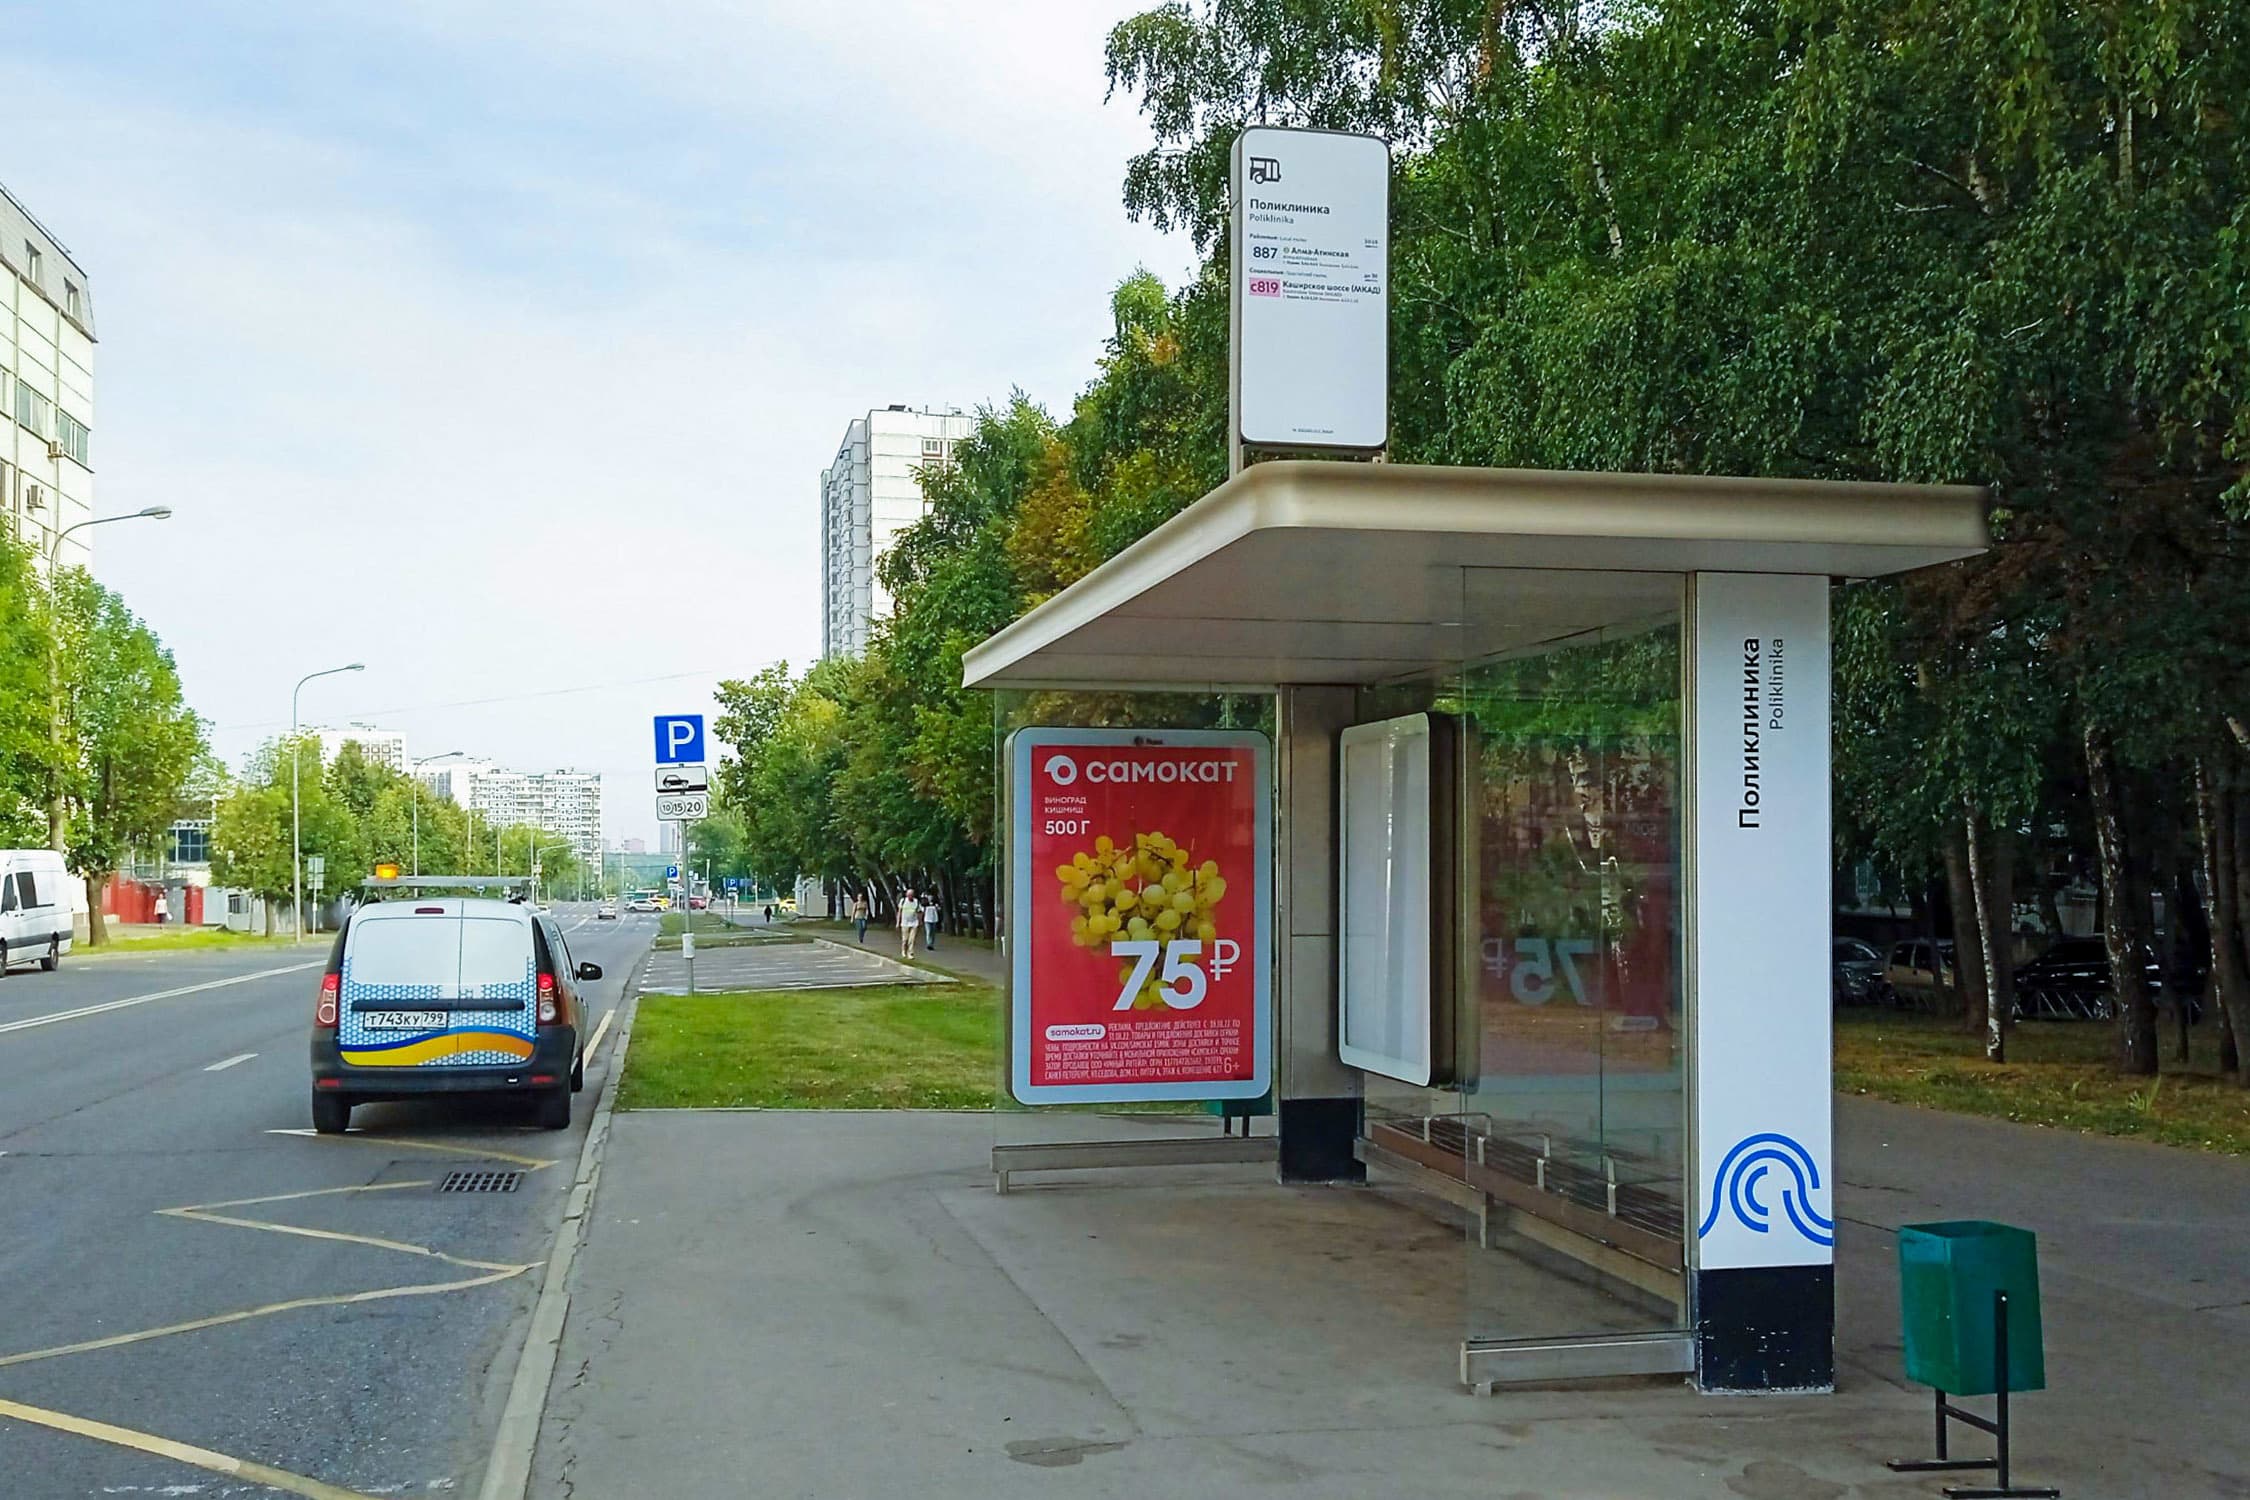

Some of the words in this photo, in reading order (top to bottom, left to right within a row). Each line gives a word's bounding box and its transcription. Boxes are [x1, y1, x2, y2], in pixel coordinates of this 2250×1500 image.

[1249, 199, 1331, 215] Поликлиника
[1249, 213, 1295, 224] Poliklinika
[1253, 246, 1278, 259] 887
[1291, 247, 1349, 258] Алма-Атинская
[1250, 281, 1279, 294] с819
[1282, 280, 1326, 291] Каширское
[1351, 284, 1381, 295] (МКАД)
[1768, 638, 1784, 730] Poliklinika
[668, 720, 695, 759] P
[1738, 638, 1760, 828] Поликлиника
[1086, 761, 1238, 783] самокат
[662, 804, 671, 812] 10
[674, 803, 684, 812] 15
[687, 802, 701, 812] 20
[1044, 797, 1087, 805] ВИНОГРАД
[1044, 806, 1084, 814] КИШМИШ
[1045, 820, 1077, 835] 500
[1081, 820, 1091, 834] Г
[423, 1012, 444, 1022] 799
[1050, 1027, 1102, 1036] samokat.ru
[1223, 1056, 1240, 1074] 6+
